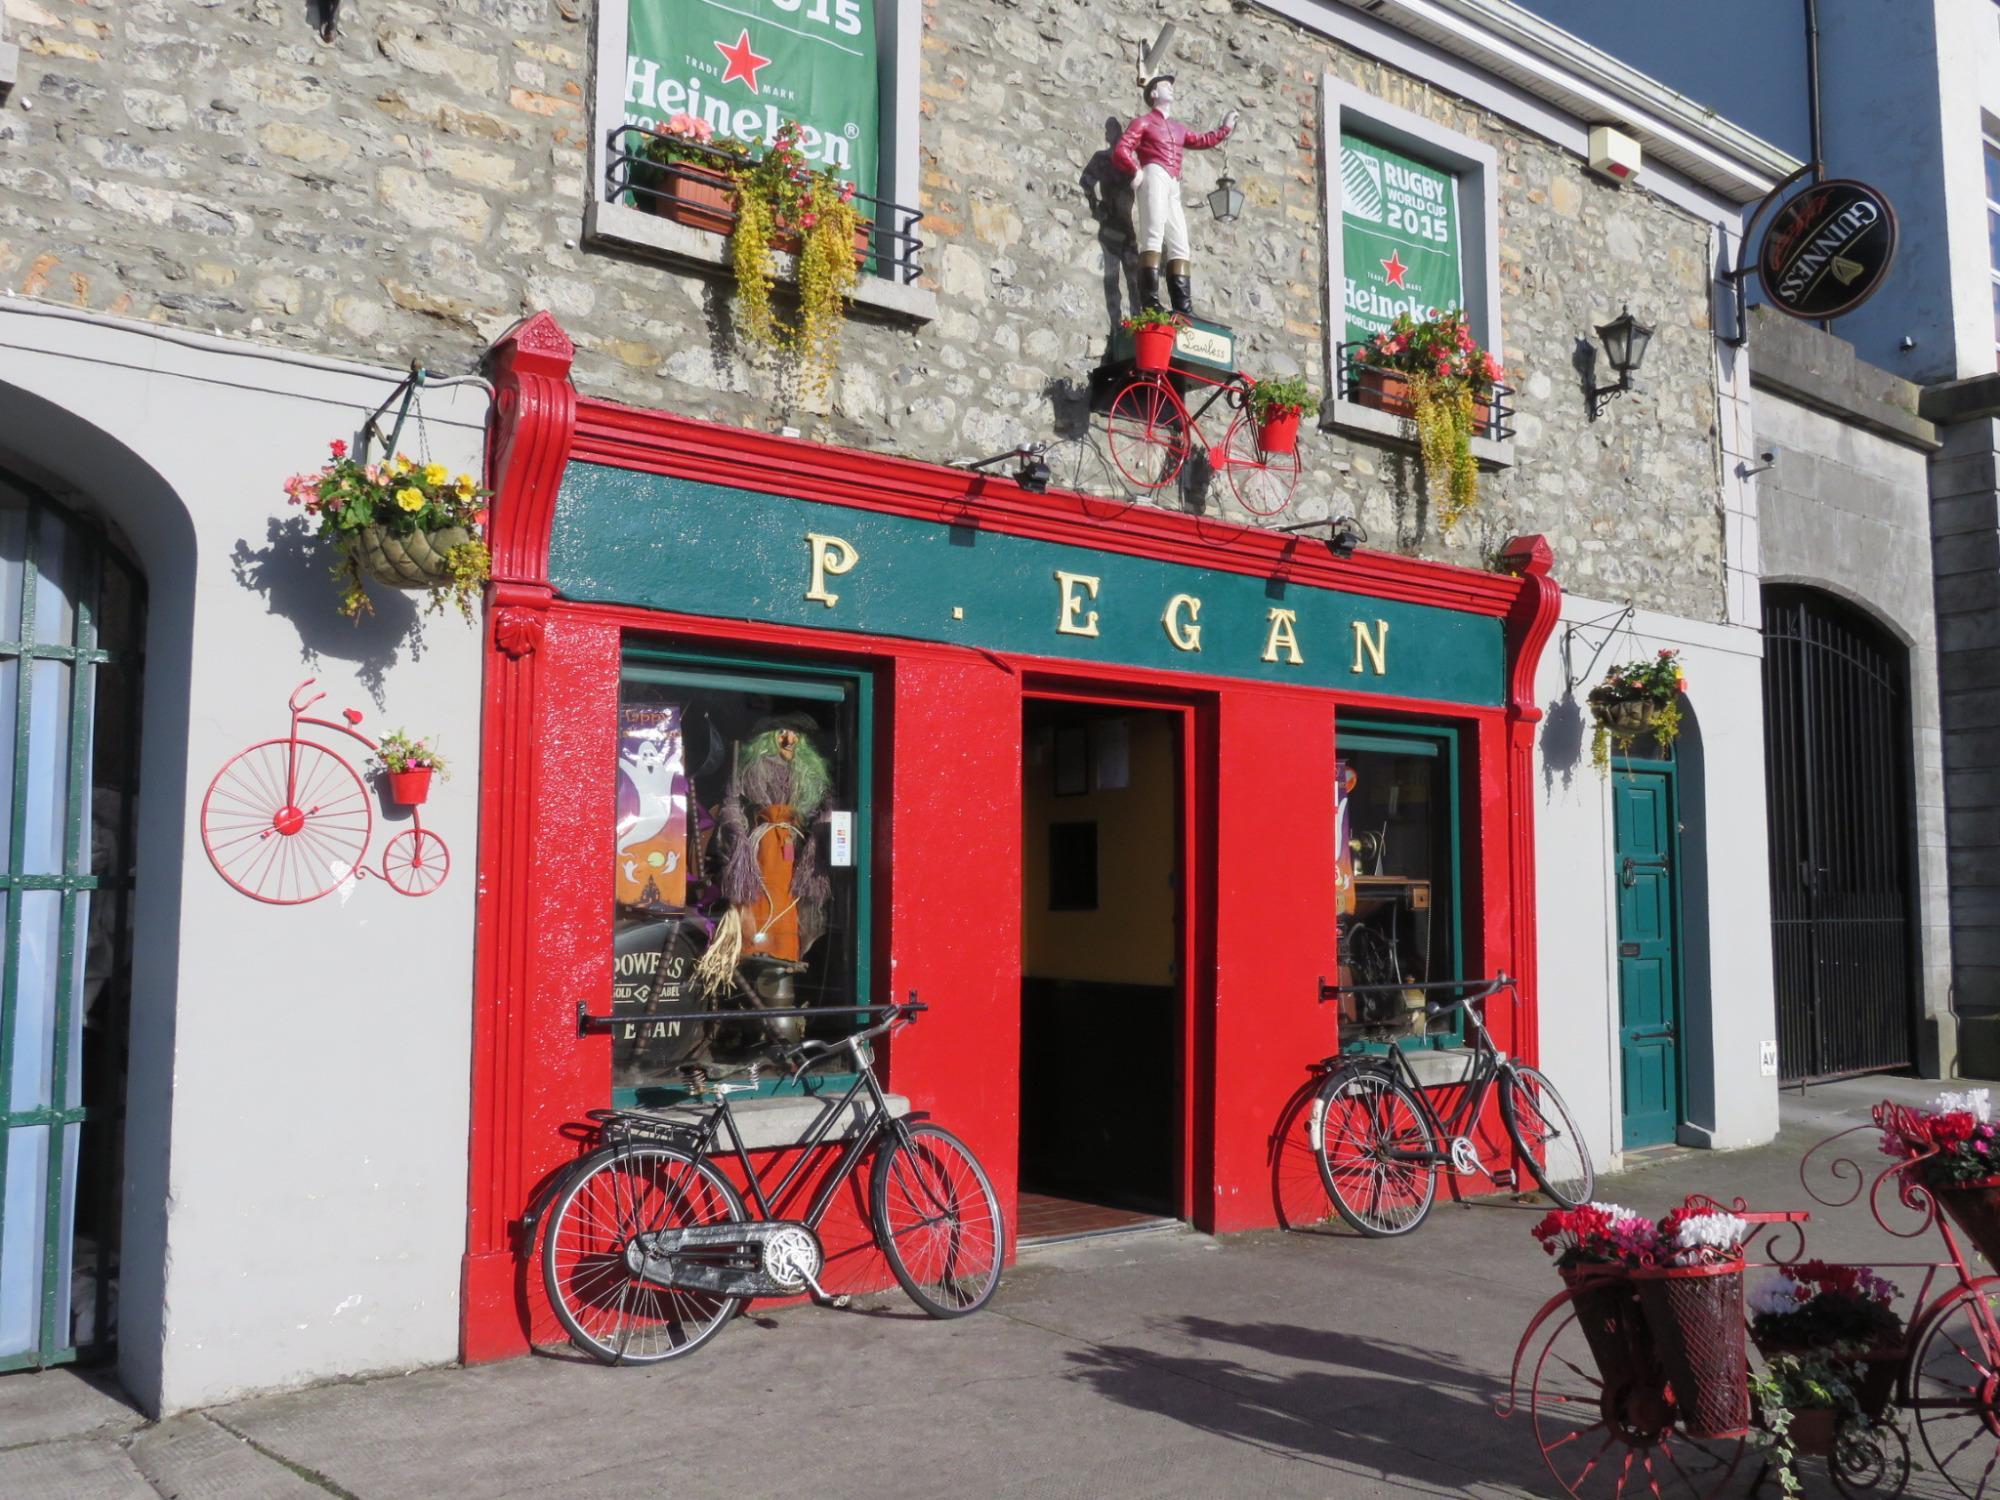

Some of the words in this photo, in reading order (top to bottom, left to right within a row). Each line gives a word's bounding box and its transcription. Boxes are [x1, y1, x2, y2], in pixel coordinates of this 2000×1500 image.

[685, 54, 719, 78] TRADE
[761, 84, 796, 101] MARK
[1383, 161, 1444, 204] RUGBY
[1386, 187, 1425, 211] WORLD
[1426, 202, 1448, 218] CUP
[1386, 203, 1449, 243] 2015
[1779, 200, 1878, 303] GUINNESS
[1053, 570, 1390, 676] EGAN
[624, 1020, 681, 1040] EAN
